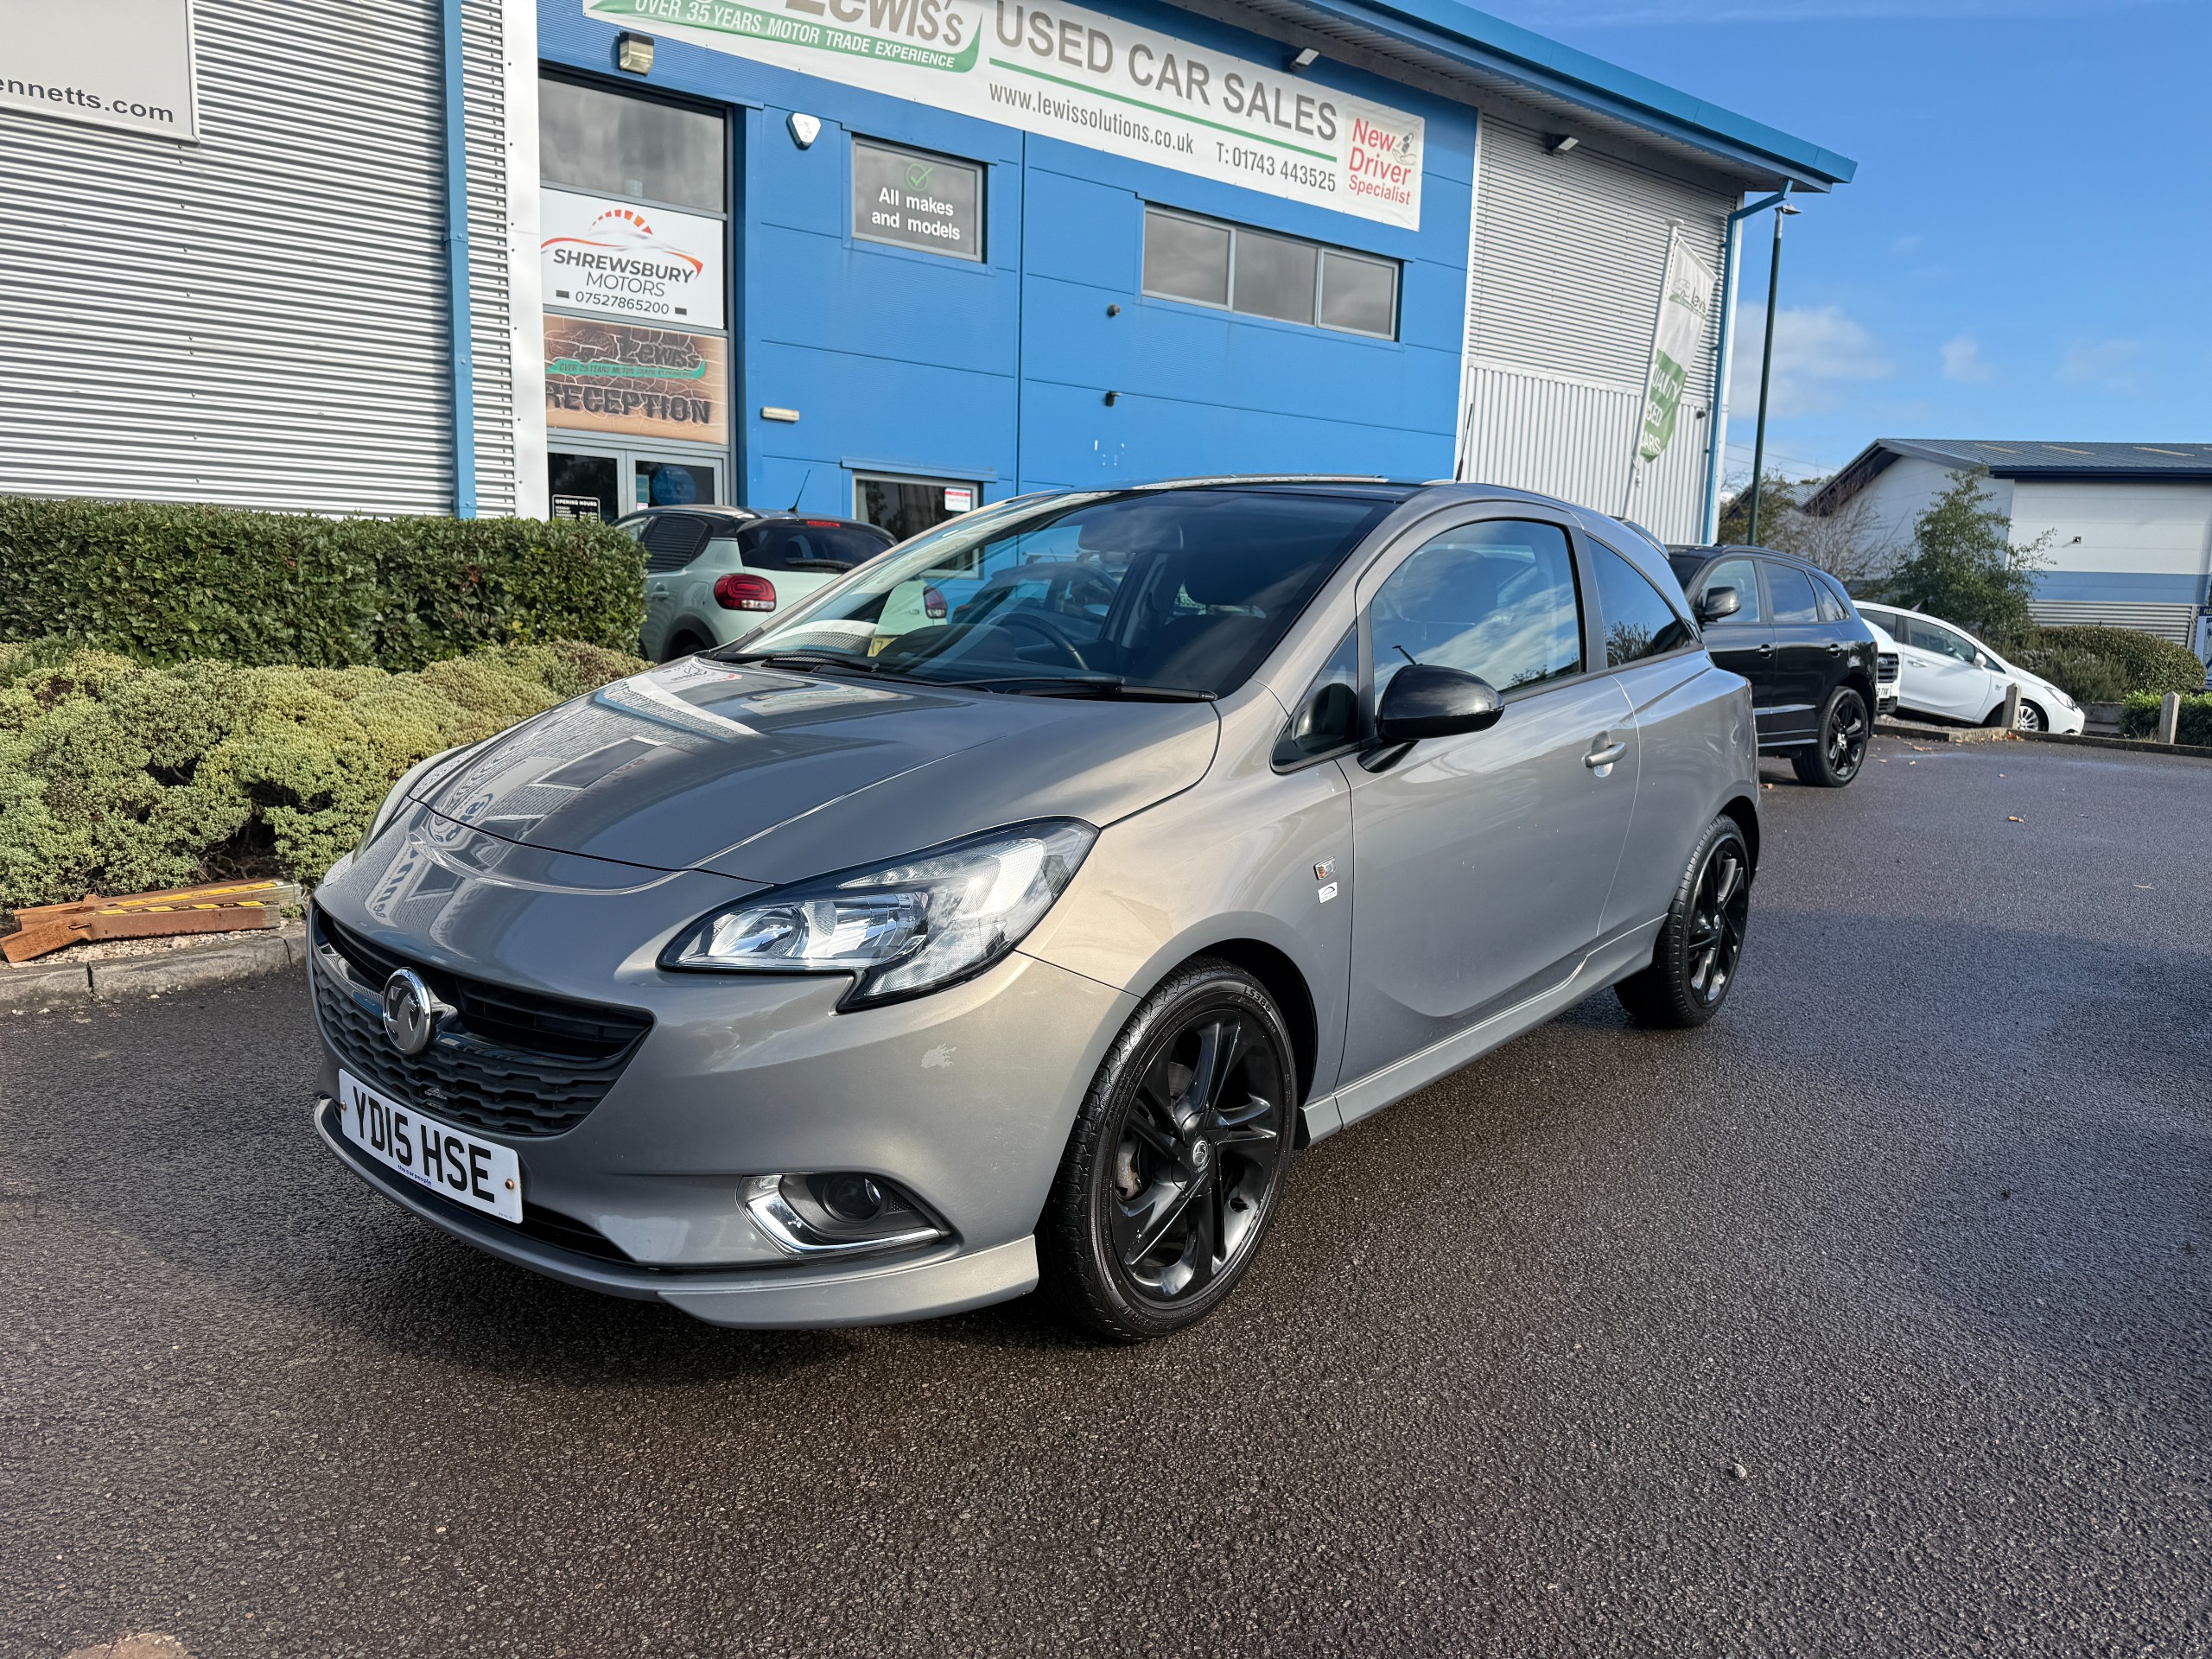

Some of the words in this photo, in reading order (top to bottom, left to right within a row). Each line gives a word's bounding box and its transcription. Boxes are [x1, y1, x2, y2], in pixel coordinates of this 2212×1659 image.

[635, 0, 681, 17] OVER
[686, 2, 710, 23] 35
[713, 5, 762, 33] YEARS
[766, 17, 821, 45] MOTOR
[825, 29, 871, 54] TRADE
[874, 41, 955, 68] EXPERIENCE
[995, 0, 1113, 74] USED
[1128, 43, 1210, 106] CAR
[1223, 72, 1337, 141] SALES
[0, 79, 174, 123] ennetts.com
[989, 82, 1193, 156] www.lewissolutions.co.uk
[1280, 161, 1336, 192] 443525
[1352, 118, 1396, 153] New
[1349, 146, 1412, 186] Driver
[878, 187, 899, 207] All
[906, 195, 954, 217] makes
[1349, 174, 1411, 205] Specialist
[871, 211, 900, 229] and
[907, 218, 961, 241] models
[553, 248, 694, 284] SHREWSBURY
[586, 271, 666, 297] MOTORS
[575, 290, 670, 315] 07527865200
[353, 1085, 412, 1166] YD15
[421, 1124, 494, 1203] HSE
